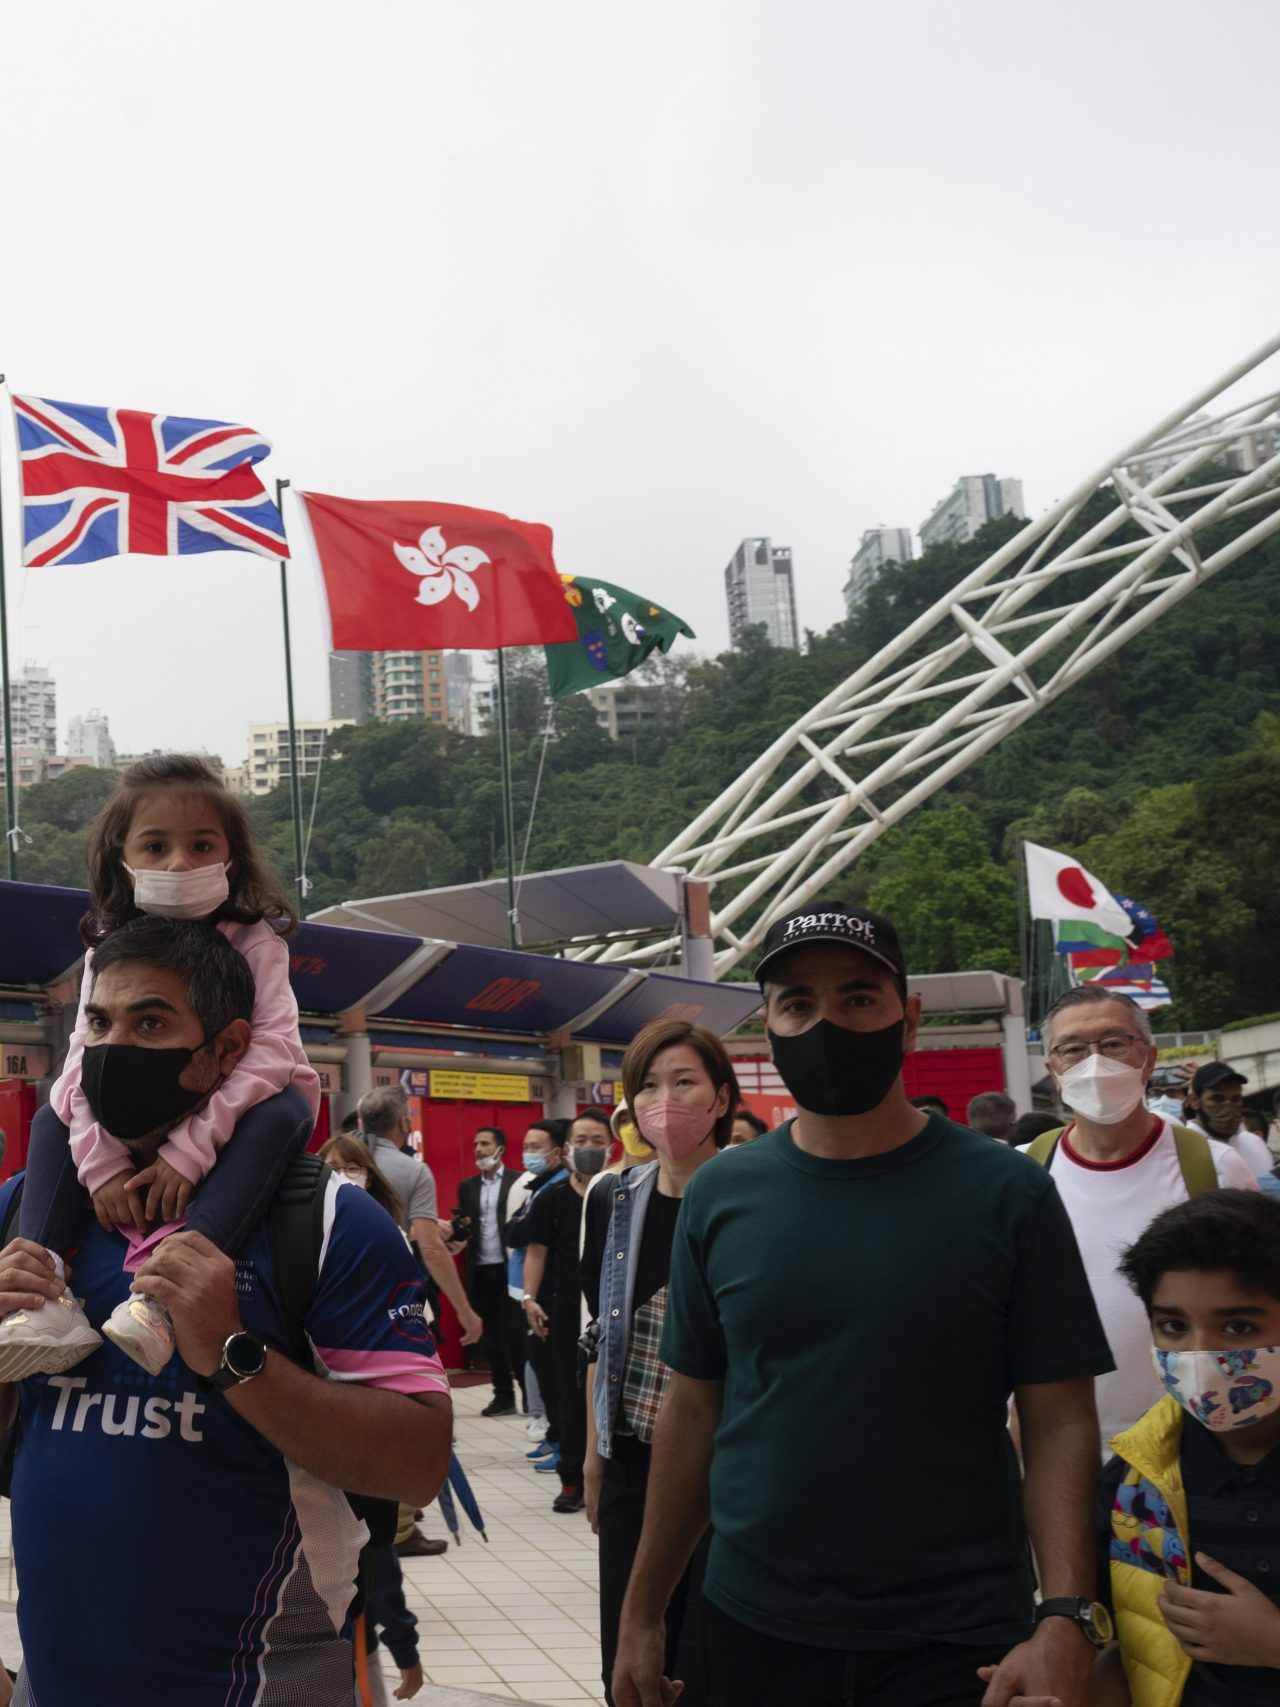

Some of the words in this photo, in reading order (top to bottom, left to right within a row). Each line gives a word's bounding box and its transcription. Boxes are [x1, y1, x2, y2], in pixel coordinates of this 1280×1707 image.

[783, 912, 875, 938] Parrot
[6, 1055, 28, 1075] 16A
[235, 1281, 252, 1292] lub
[47, 1375, 206, 1442] Trust
